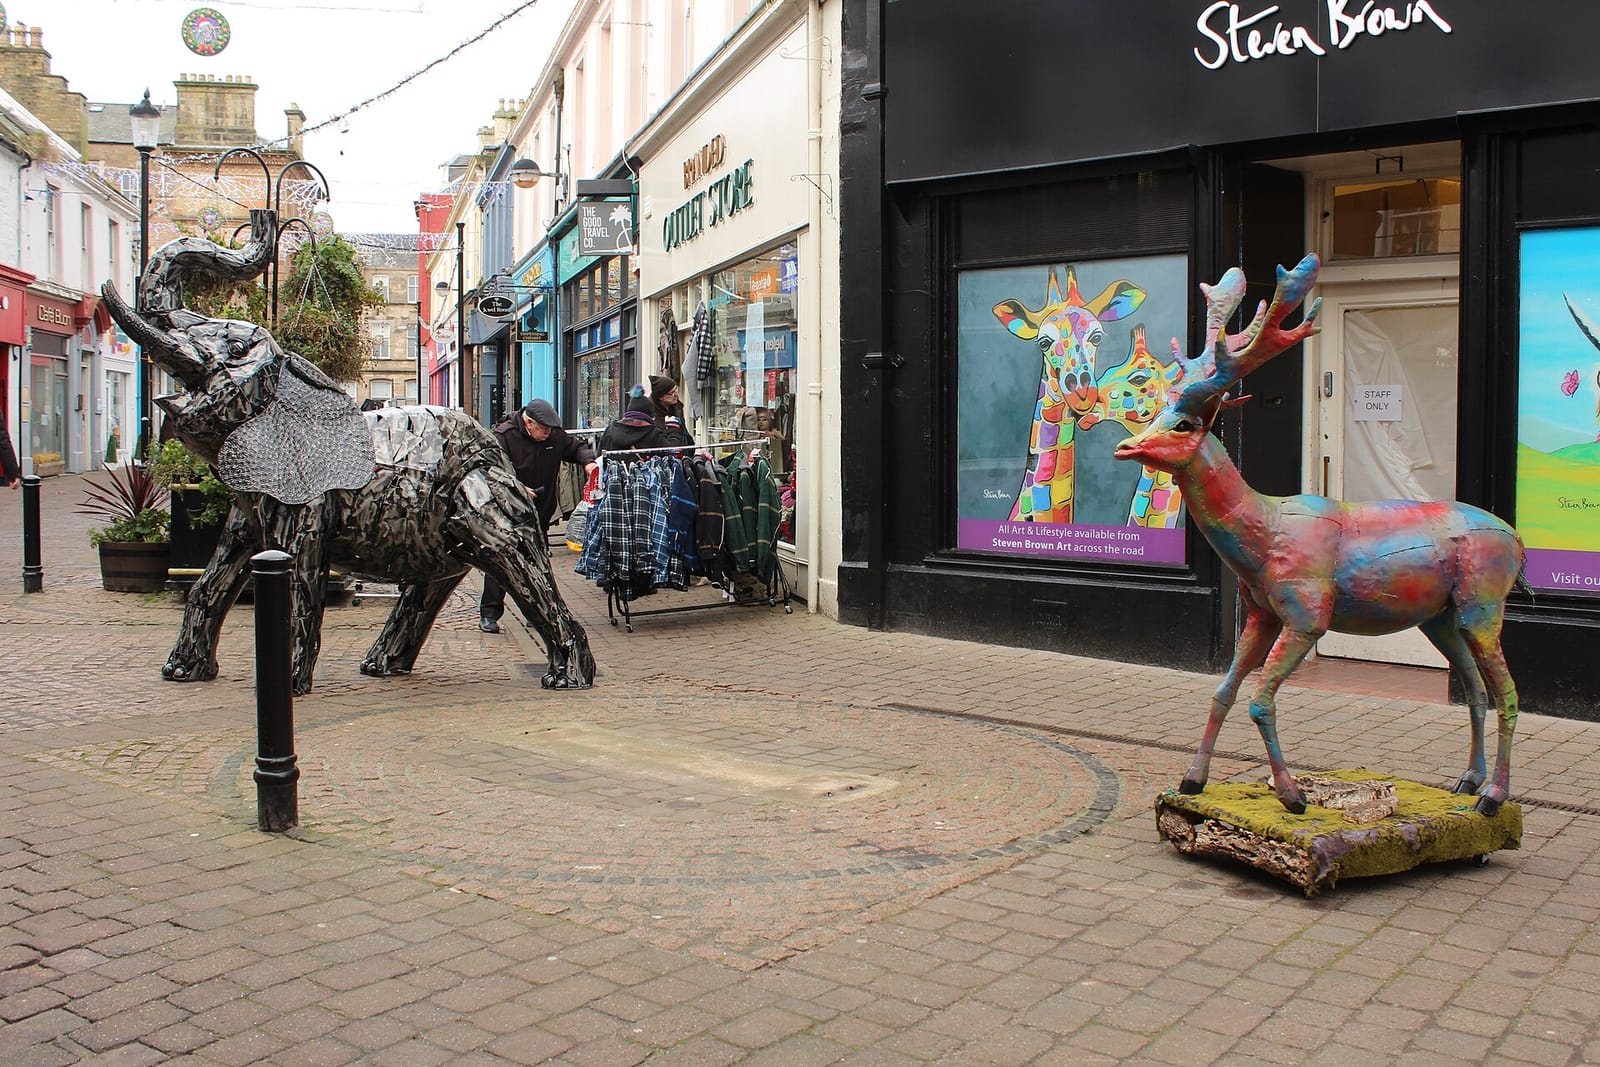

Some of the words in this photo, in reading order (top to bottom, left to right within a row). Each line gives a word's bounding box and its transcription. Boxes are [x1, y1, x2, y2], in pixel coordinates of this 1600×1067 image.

[1194, 1, 1326, 70] Steven
[1326, 0, 1453, 49] Brown
[663, 190, 706, 253] OUTLET
[708, 158, 755, 227] STORE
[582, 206, 597, 217] THE
[582, 216, 602, 227] GOOD
[583, 227, 610, 238] TRAVEL
[583, 237, 596, 248] CO.
[1363, 390, 1392, 400] STAFF
[1365, 402, 1390, 411] ONLY
[998, 524, 1010, 534] All
[1011, 525, 1025, 535] Art
[1026, 526, 1034, 535] &
[1035, 526, 1073, 539] Lifestyle
[1074, 529, 1115, 540] available
[1117, 530, 1140, 541] from
[992, 538, 1023, 548] Steven
[1024, 539, 1054, 550] Brown
[1056, 541, 1072, 551] Art
[1073, 544, 1103, 553] across
[1104, 544, 1120, 554] the
[1122, 546, 1144, 556] road
[1551, 571, 1581, 585] Visit
